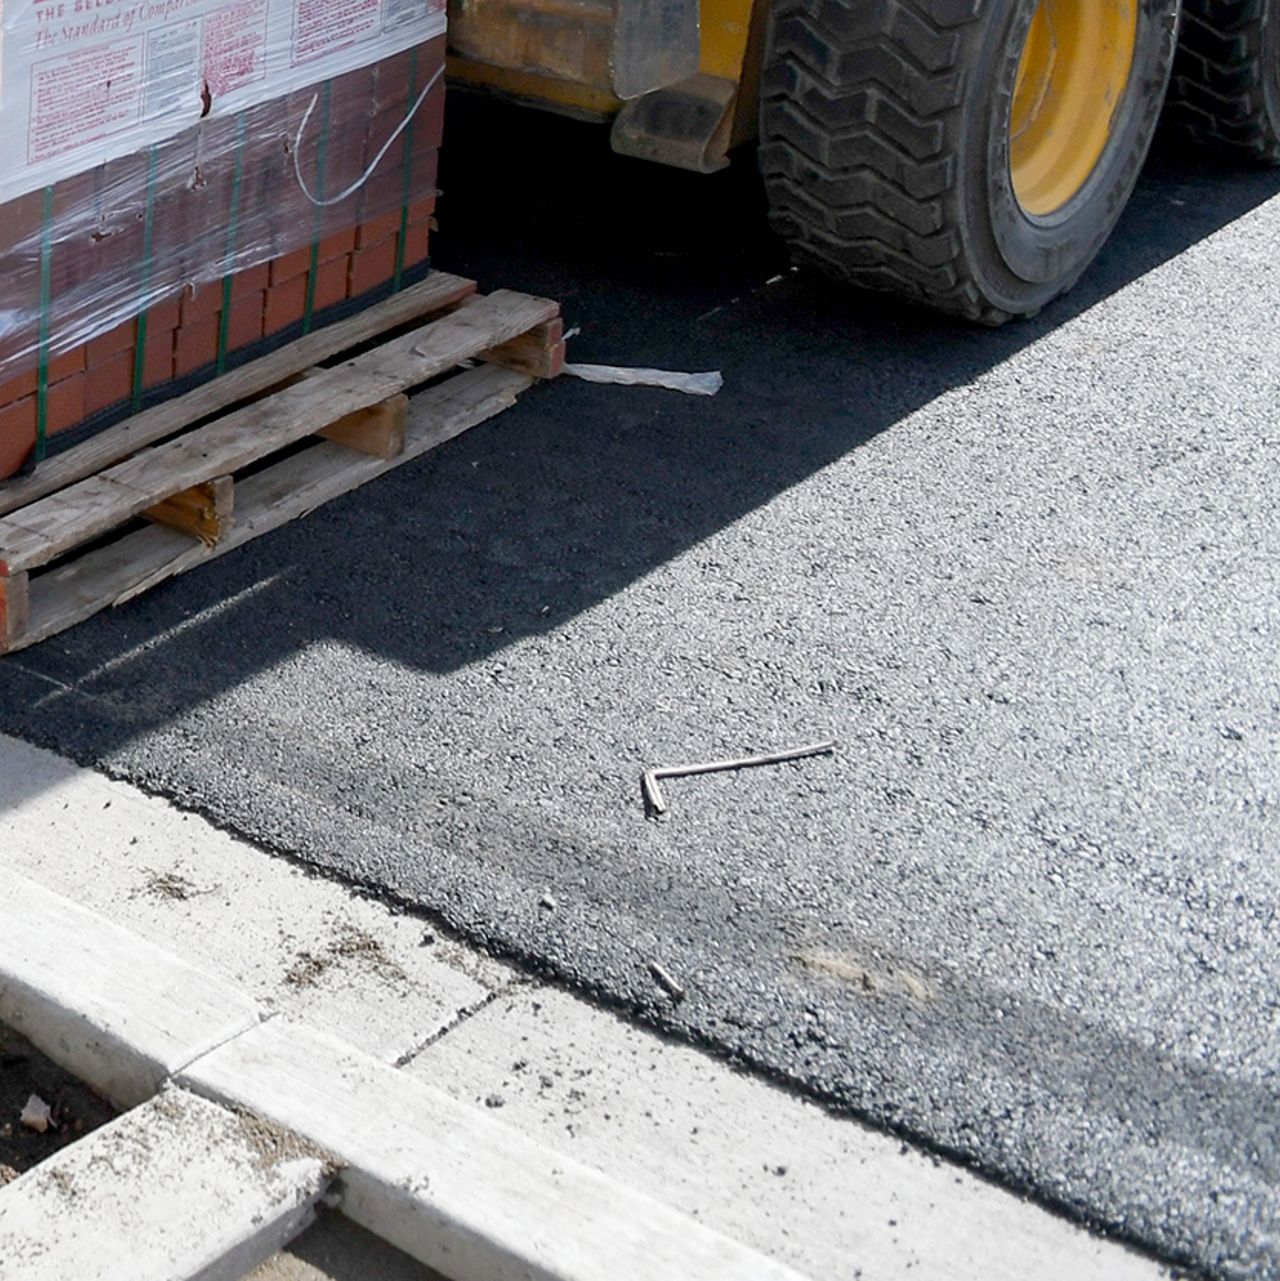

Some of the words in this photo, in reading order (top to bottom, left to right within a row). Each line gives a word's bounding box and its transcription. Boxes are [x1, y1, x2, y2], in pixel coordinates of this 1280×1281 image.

[34, 28, 60, 48] The
[61, 10, 121, 41] Standard
[122, 8, 139, 32] of
[36, 4, 66, 23] THE
